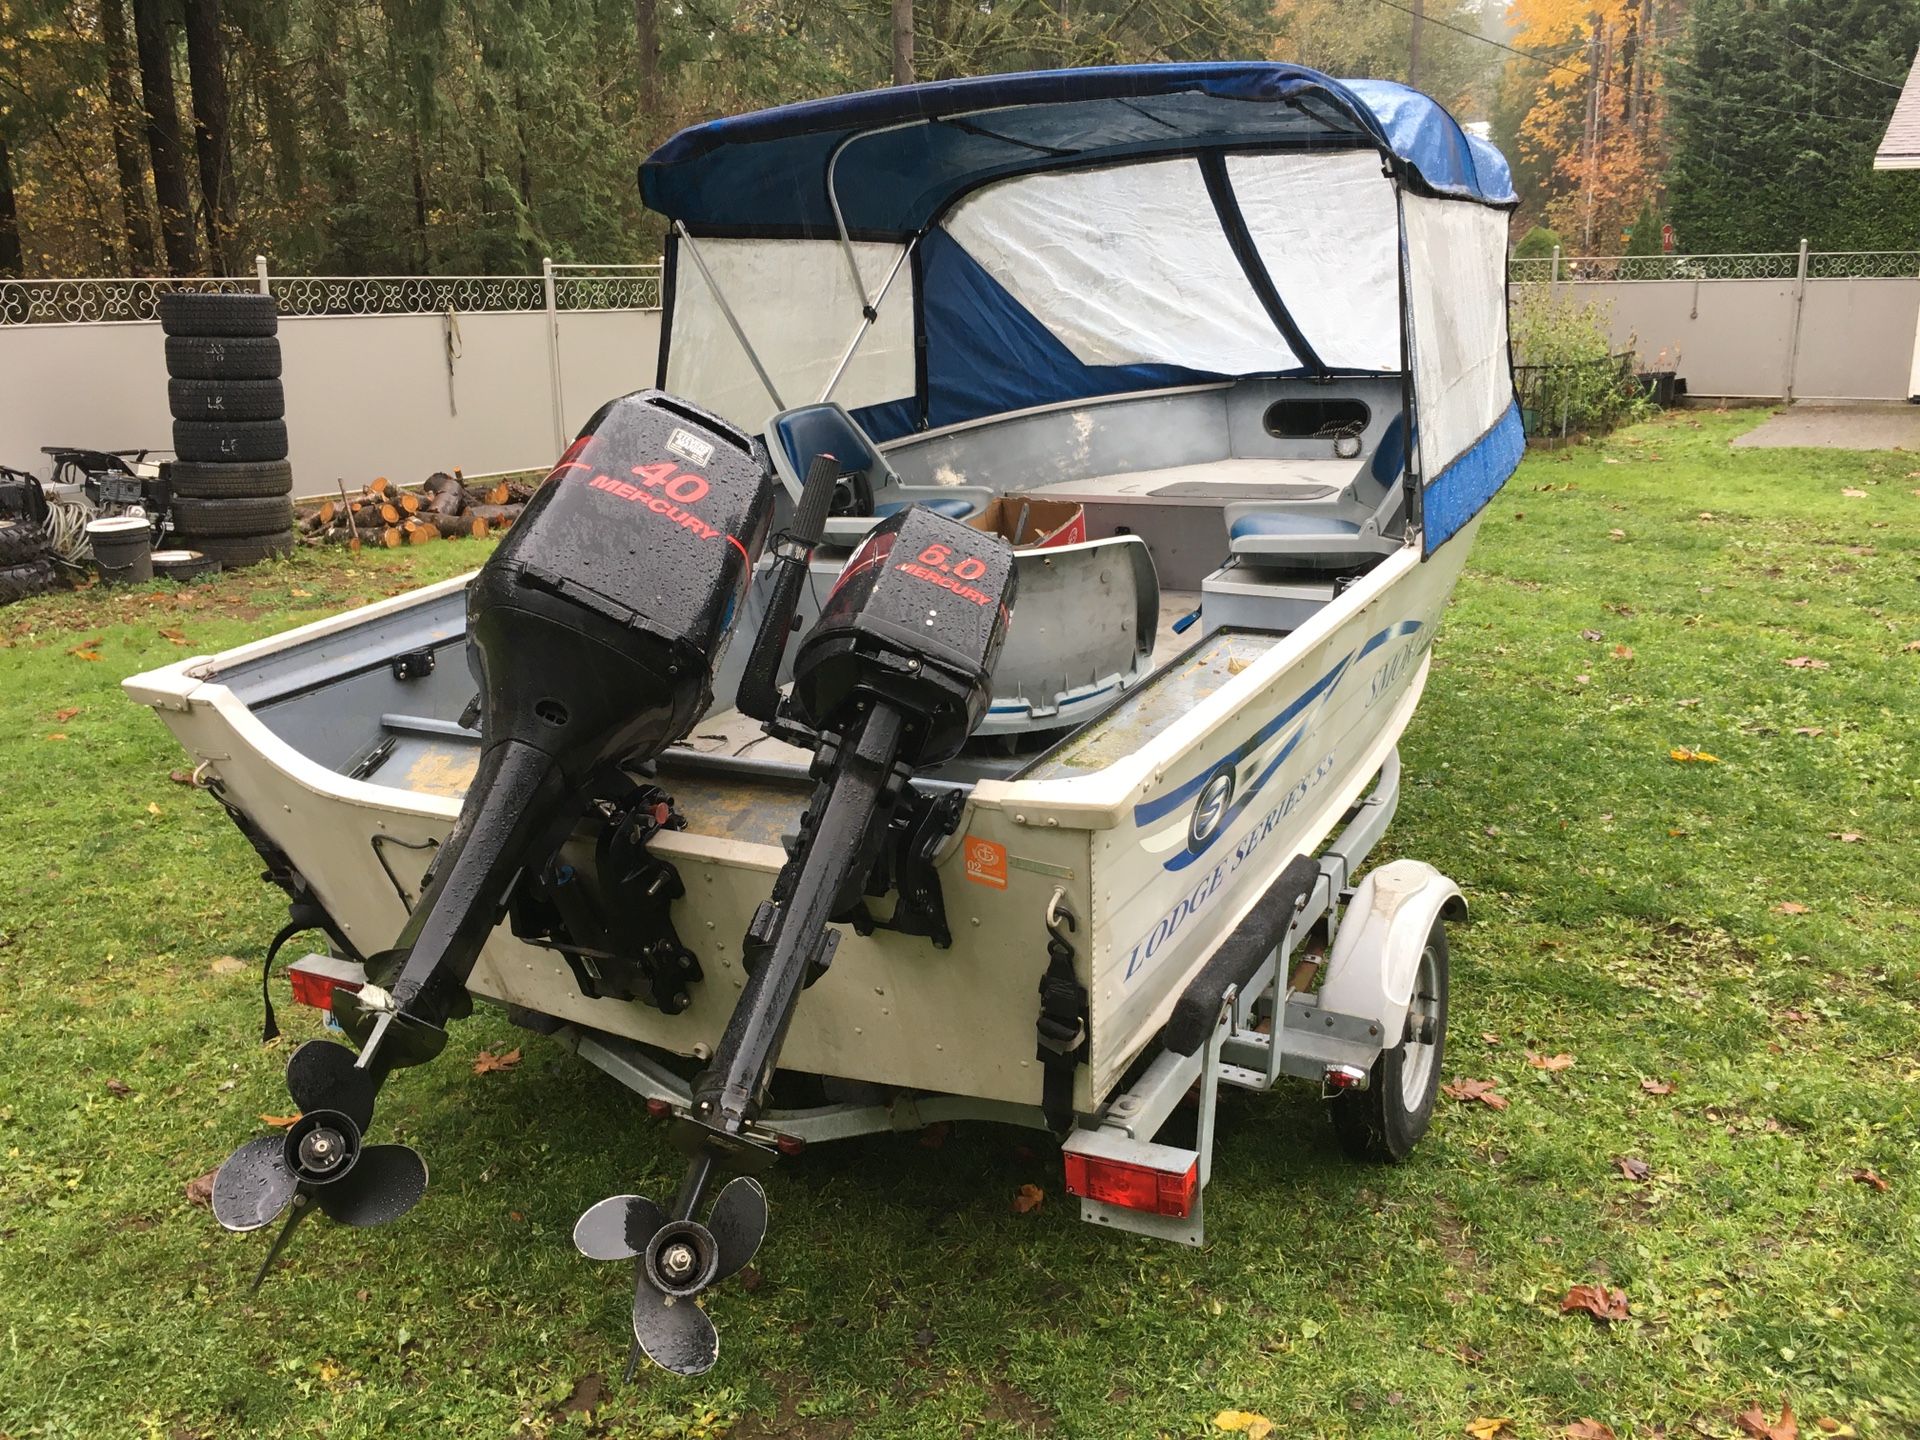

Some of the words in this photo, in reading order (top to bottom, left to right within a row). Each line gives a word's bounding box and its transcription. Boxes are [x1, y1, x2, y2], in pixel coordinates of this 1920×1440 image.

[631, 460, 709, 503] 40
[589, 475, 721, 541] MERCURY
[917, 543, 987, 580] 6.0
[894, 562, 994, 607] MERCURY
[967, 860, 982, 873] 02
[1123, 858, 1229, 983] LODGE
[1230, 773, 1311, 873] SERIES
